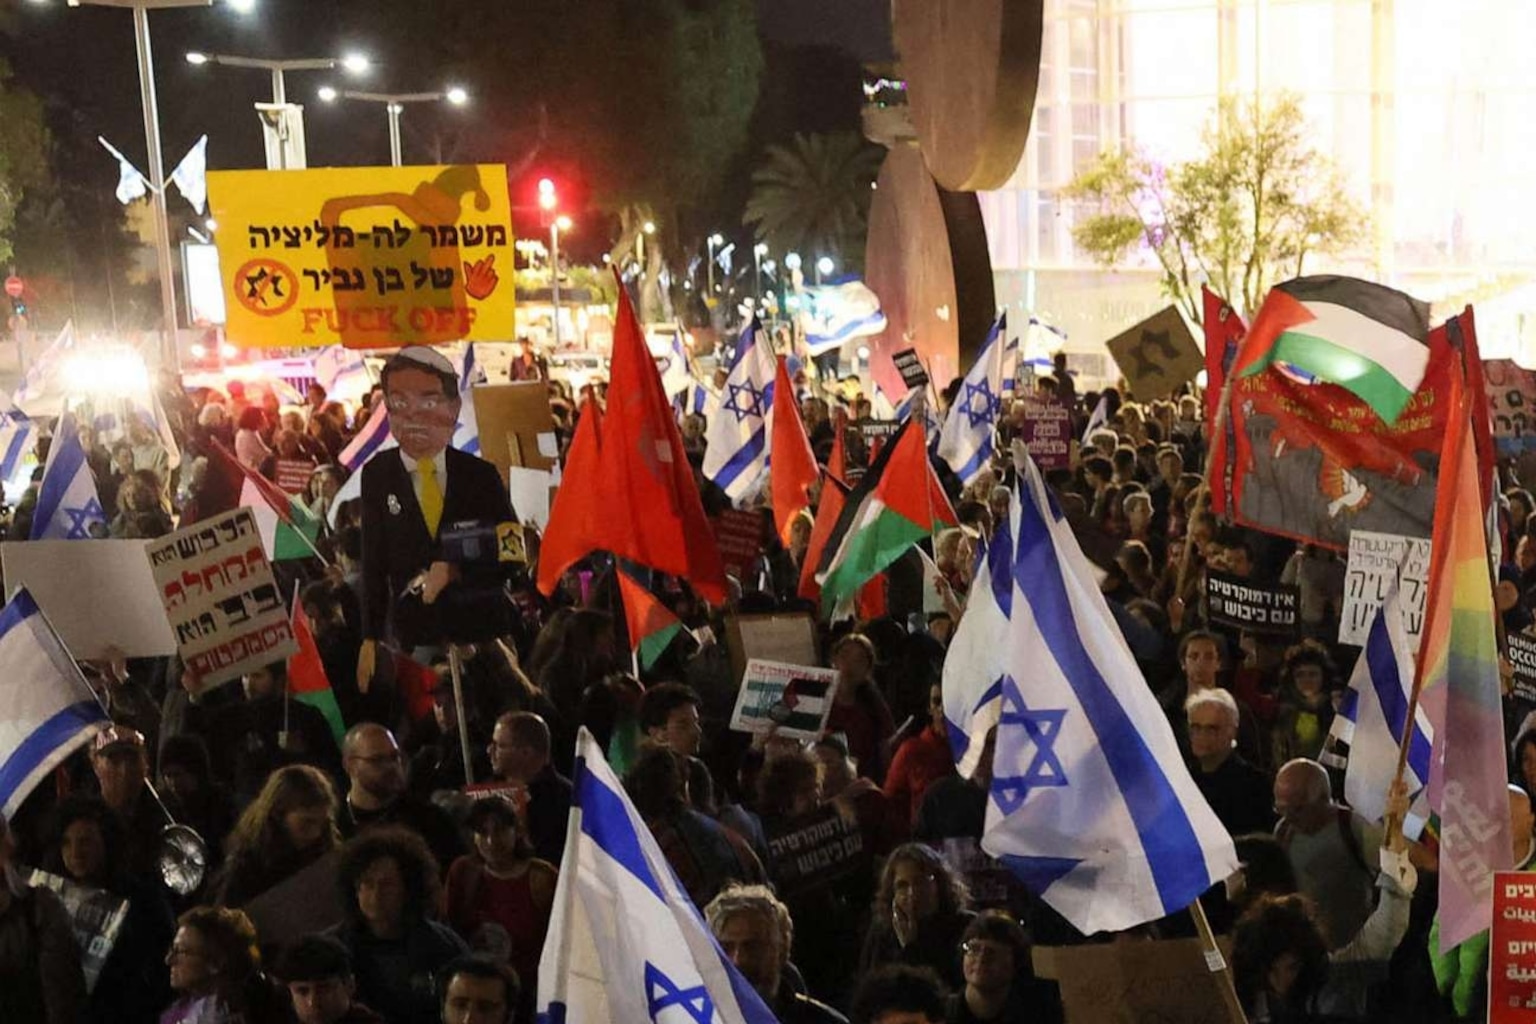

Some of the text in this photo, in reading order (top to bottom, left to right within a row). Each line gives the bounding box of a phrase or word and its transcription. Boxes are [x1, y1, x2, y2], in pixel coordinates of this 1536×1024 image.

[248, 219, 507, 249] משמר לה-מליציה
[303, 260, 455, 296] של בן גביר
[301, 304, 478, 335] FUCK OFF
[151, 511, 255, 567] הכיבוש הוא
[164, 546, 269, 613] המחלה
[1209, 577, 1295, 608] אין דמוקרטיה
[176, 582, 284, 645] ביבי הוא
[1224, 601, 1296, 625] עם כיבוש
[186, 618, 296, 676] הסמפטום
[768, 818, 842, 856] דמוקרטיה
[797, 841, 843, 874] כיבוש
